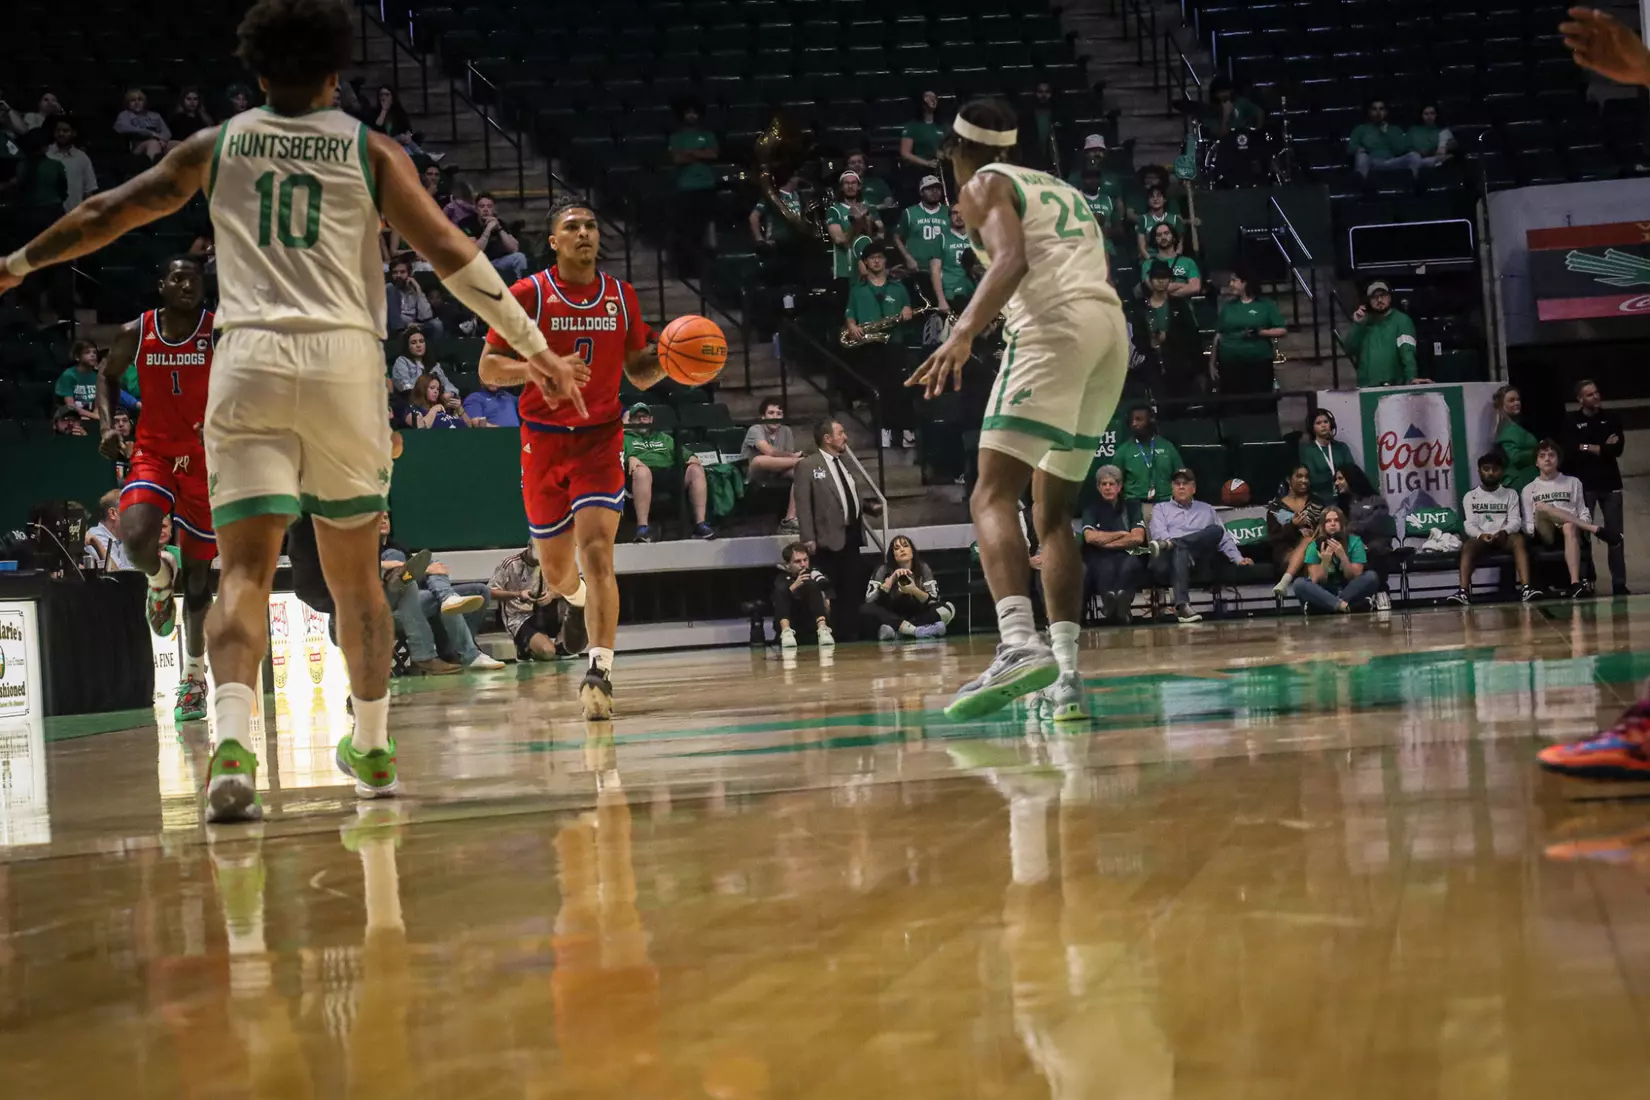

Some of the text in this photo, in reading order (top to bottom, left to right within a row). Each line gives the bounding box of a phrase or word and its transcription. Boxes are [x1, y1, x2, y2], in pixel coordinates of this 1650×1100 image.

[228, 132, 354, 162] HUNTSBERRY
[255, 171, 323, 249] 10
[1040, 191, 1098, 238] 24
[551, 317, 617, 331] BULLDOGS
[146, 353, 206, 366] BULLDOGS
[574, 336, 594, 366] 0
[171, 371, 182, 396] 1
[1377, 430, 1454, 472] Coors
[1386, 468, 1450, 494] LIGHT
[1532, 491, 1571, 501] MEAN GREEN
[1416, 512, 1449, 524] UNT
[1233, 525, 1265, 540] UNT
[0, 621, 22, 641] arie's
[160, 652, 174, 668] FINE
